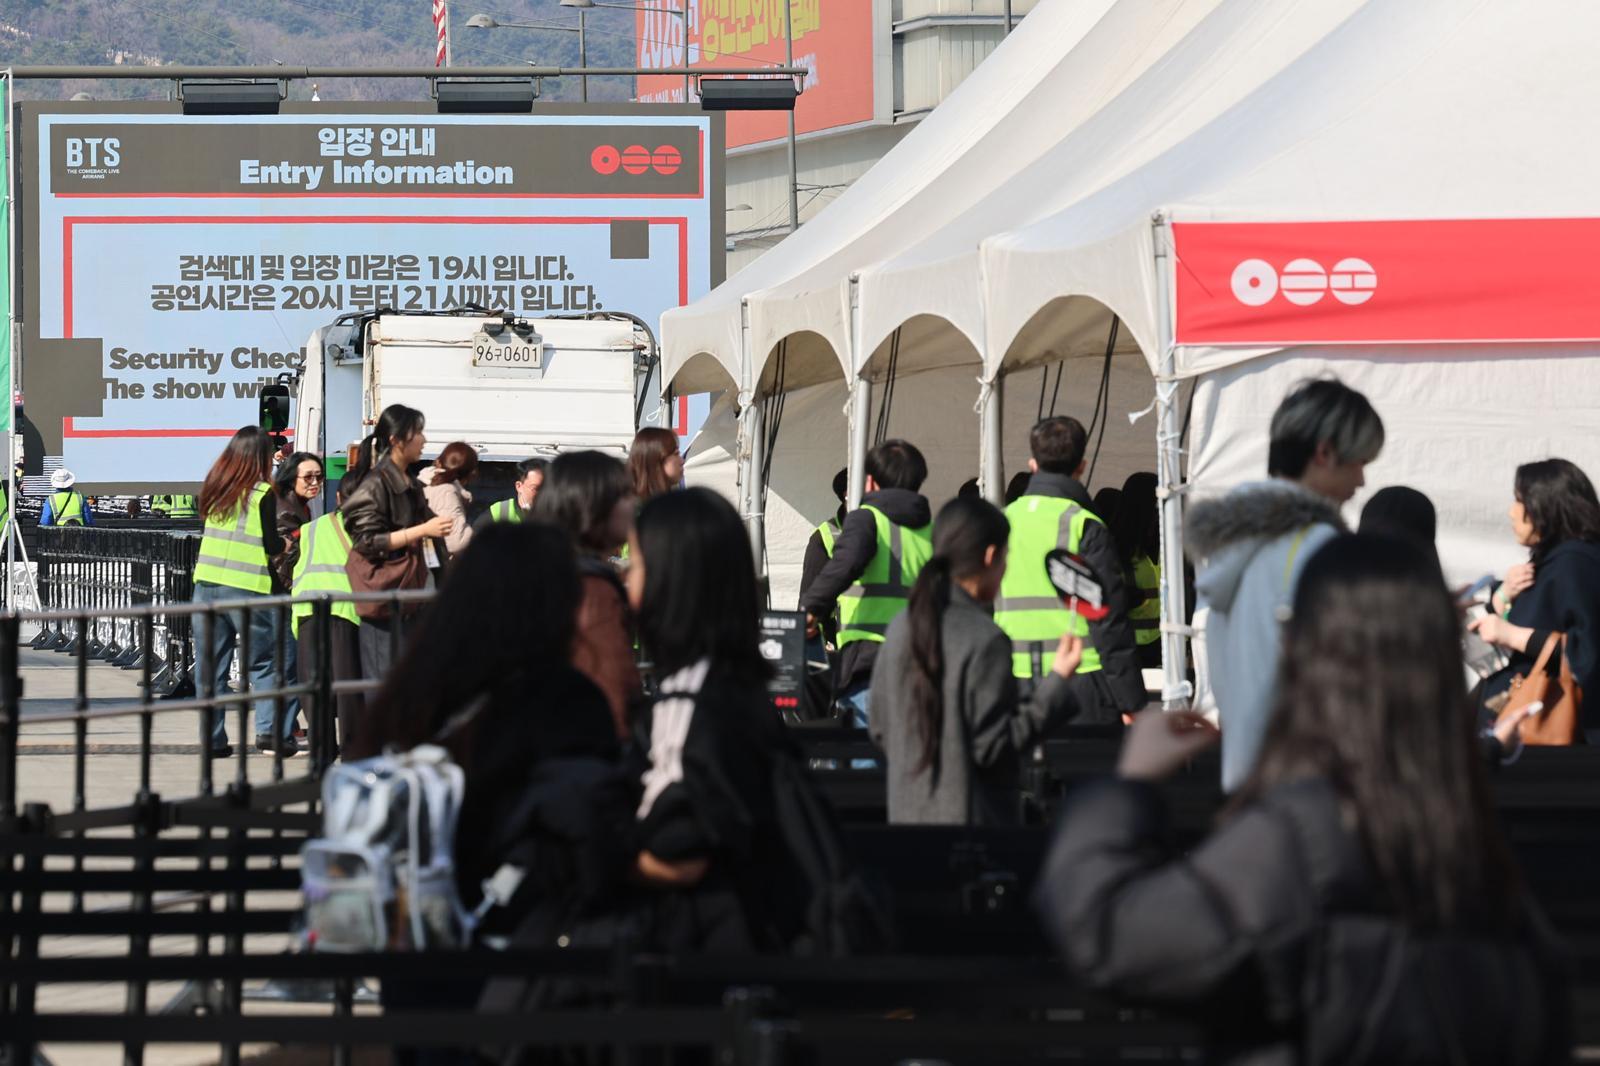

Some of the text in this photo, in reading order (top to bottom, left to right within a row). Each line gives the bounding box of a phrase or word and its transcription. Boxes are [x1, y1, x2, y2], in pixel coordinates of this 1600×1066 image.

[66, 137, 120, 167] BTS
[317, 127, 436, 157] 입장 안내
[240, 159, 514, 191] Entry Information
[179, 254, 575, 282] 검색대 및 입장 마감은 19시 입니다.
[150, 283, 604, 312] 공연시간은 20시 부터 21시까지 입니다.
[109, 346, 224, 376] Security
[476, 345, 537, 362] 96구0601
[152, 377, 227, 399] show
